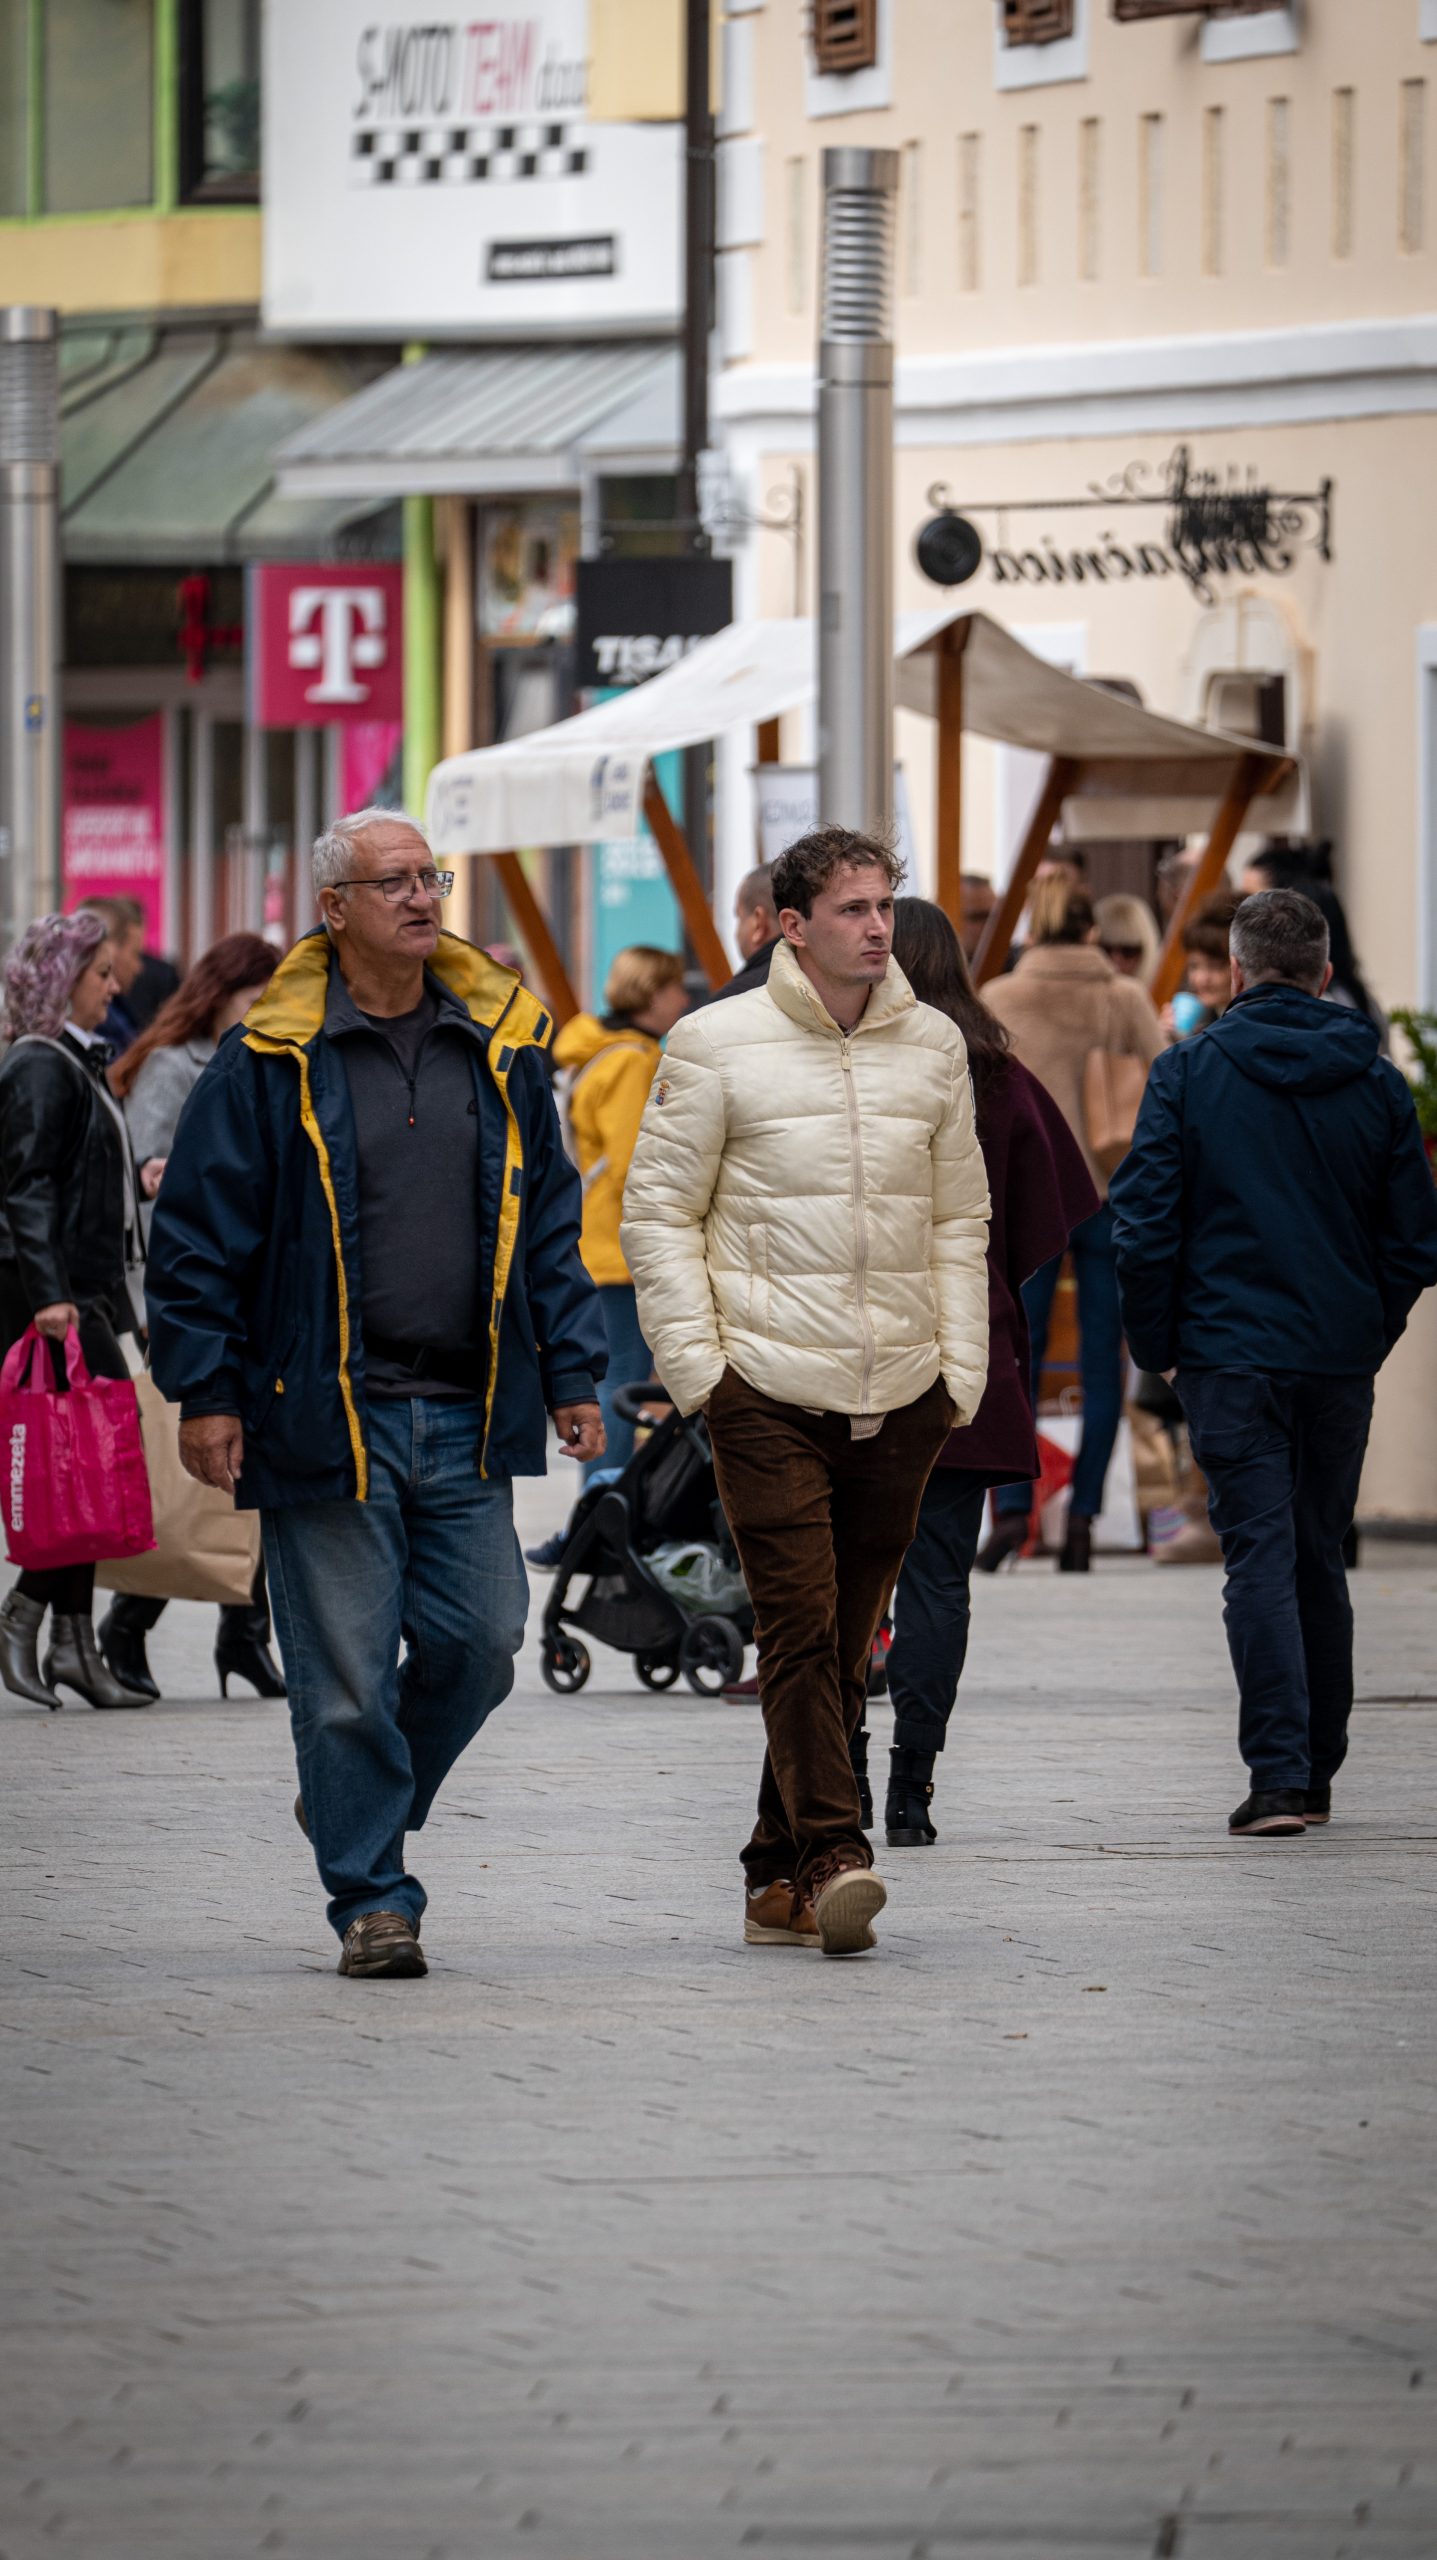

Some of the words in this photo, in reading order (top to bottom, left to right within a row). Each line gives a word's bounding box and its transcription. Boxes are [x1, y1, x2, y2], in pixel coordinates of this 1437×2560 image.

[460, 17, 539, 114] TEAM
[288, 586, 387, 703] T
[592, 634, 711, 674] TISA
[9, 1423, 26, 1532] emmezeta
